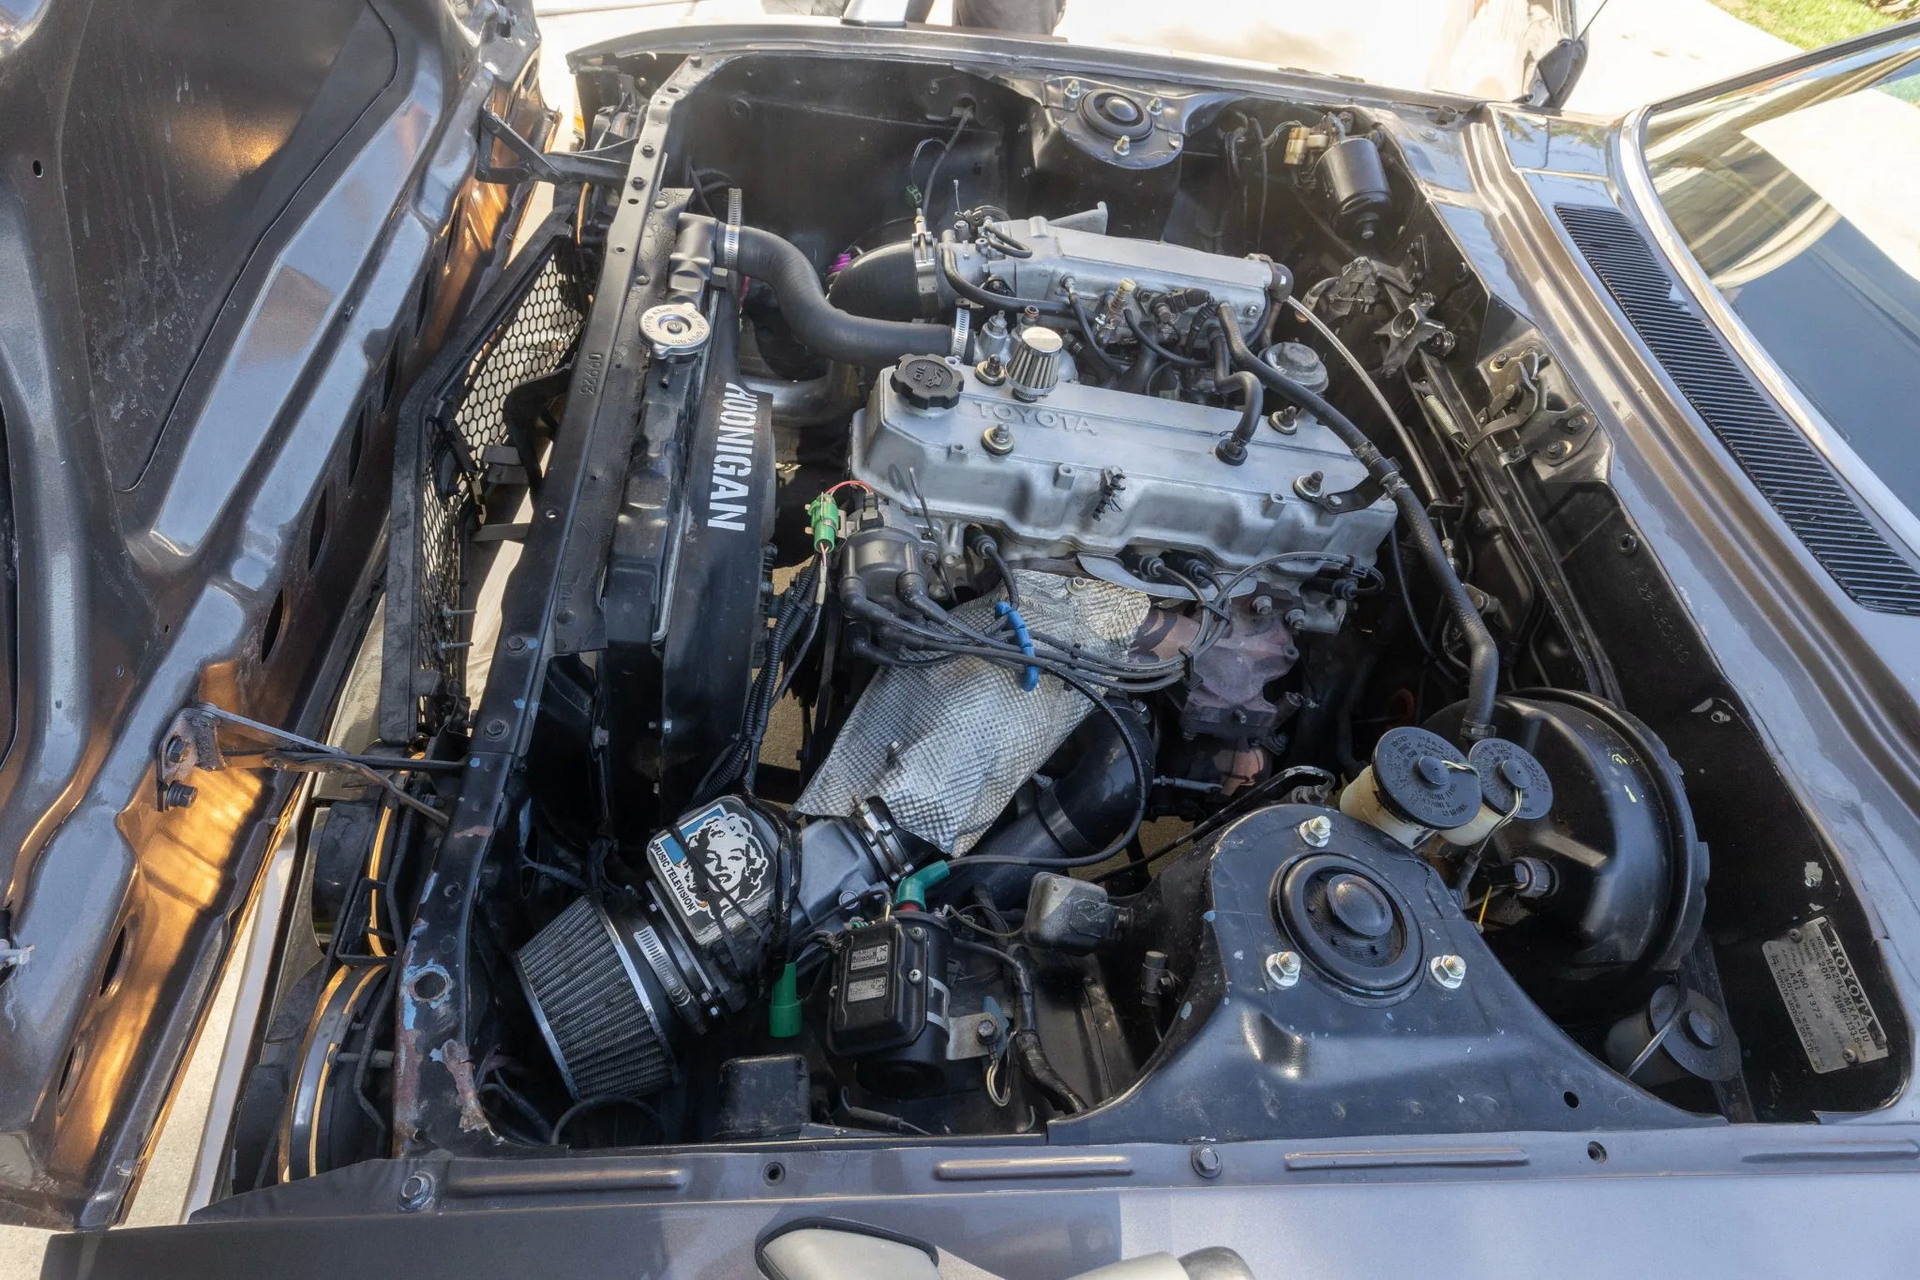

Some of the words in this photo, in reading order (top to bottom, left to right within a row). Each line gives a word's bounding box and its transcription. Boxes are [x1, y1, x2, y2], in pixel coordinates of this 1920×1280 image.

[913, 365, 927, 382] OIL
[973, 402, 1098, 436] TOYOTA
[707, 382, 758, 532] HOONIGAN
[652, 842, 671, 868] MUSIC
[665, 865, 697, 912] TELEVISION
[1776, 971, 1789, 997] TOYOTA
[1818, 960, 1831, 981] 20R
[1827, 941, 1875, 1028] TOYOTA
[1796, 969, 1809, 988] W50
[1807, 993, 1823, 1020] T372
